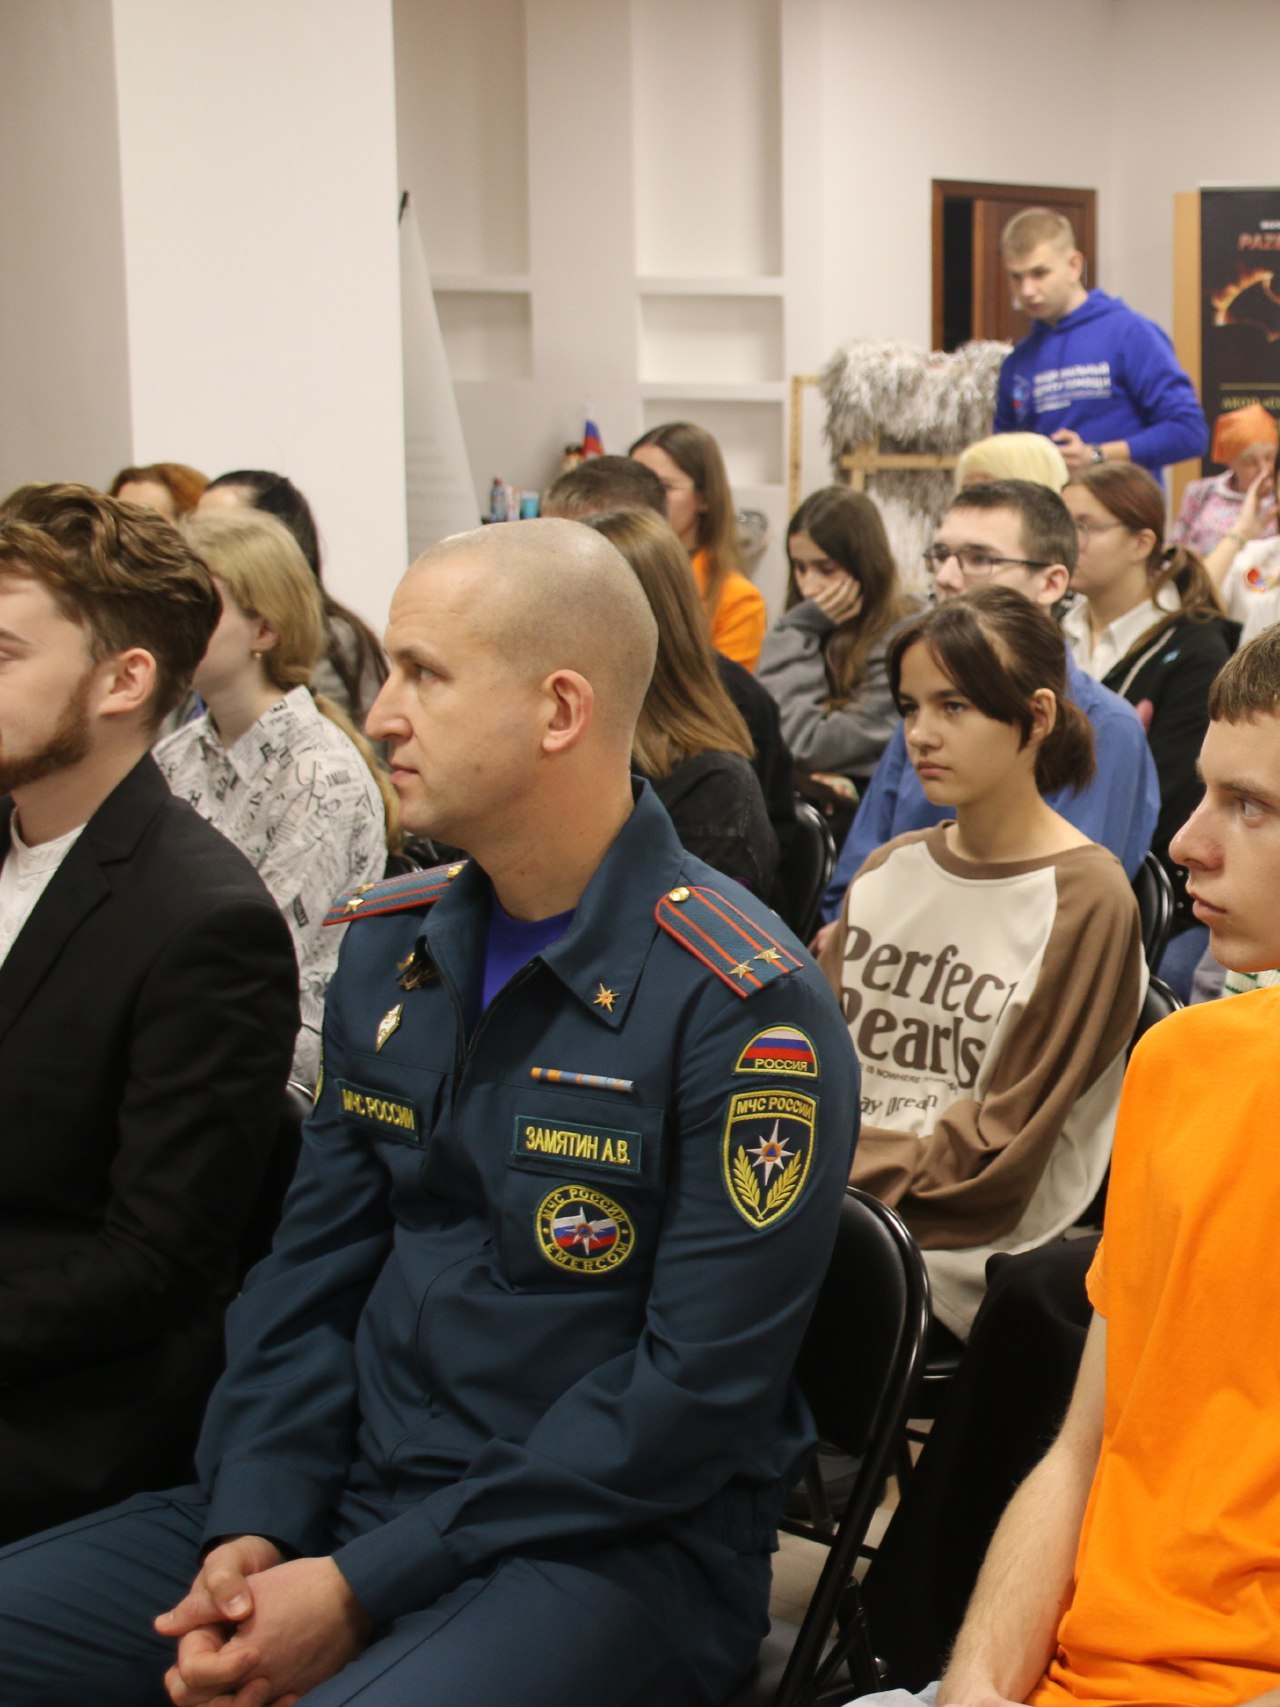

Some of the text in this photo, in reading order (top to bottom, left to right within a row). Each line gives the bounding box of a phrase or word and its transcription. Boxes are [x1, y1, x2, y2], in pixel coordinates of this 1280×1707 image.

[755, 1058, 808, 1072] РОССИЯ
[342, 1088, 415, 1130] МЧС РОССИИ
[737, 1097, 813, 1120] МЧС РОССИИ
[525, 1126, 631, 1165] ЗАМЯТИН А.В.
[541, 1187, 625, 1224] МЧС РОССИИ
[545, 1241, 630, 1271] EMERCOM
